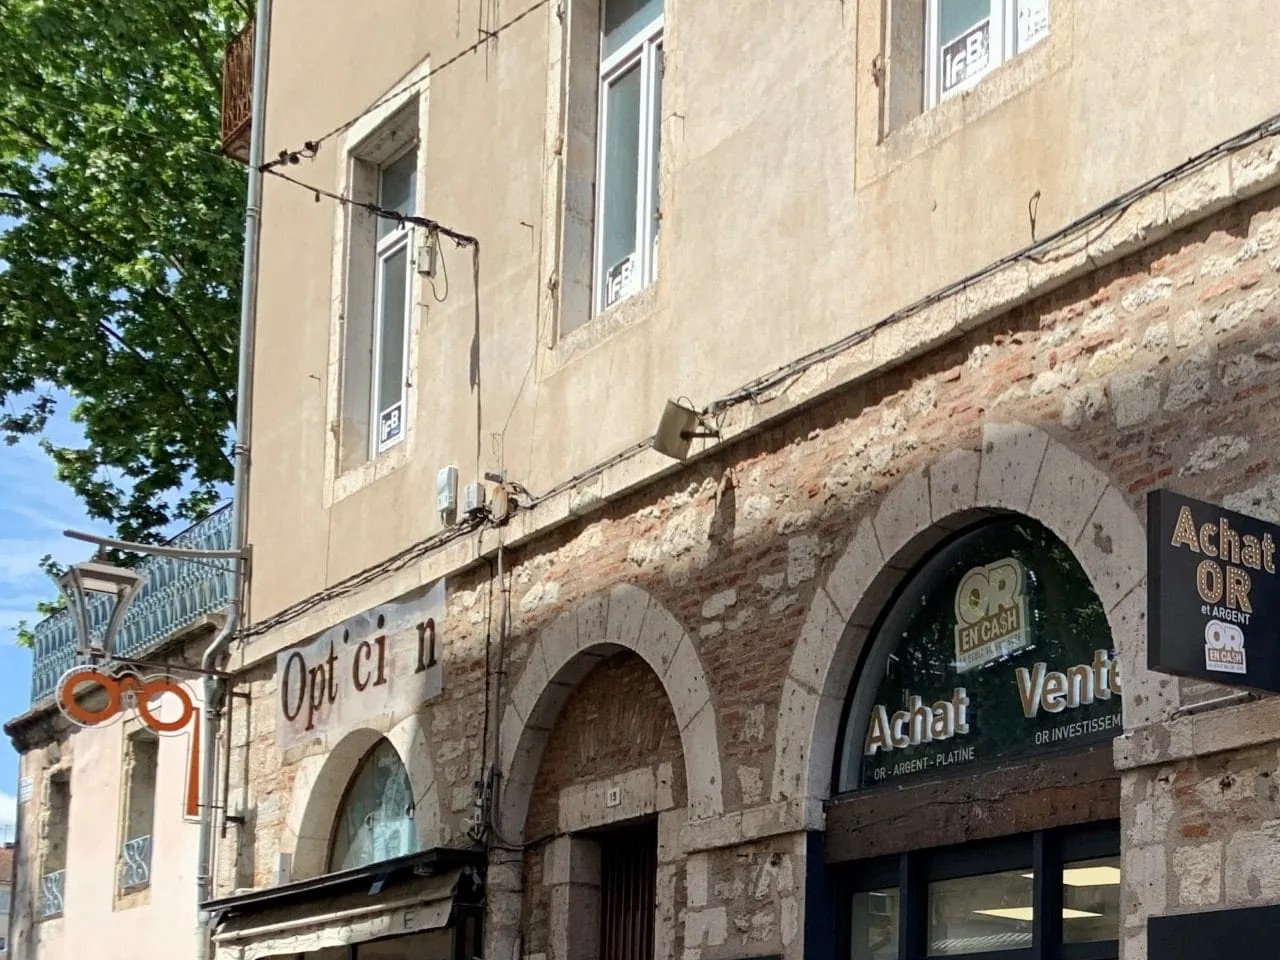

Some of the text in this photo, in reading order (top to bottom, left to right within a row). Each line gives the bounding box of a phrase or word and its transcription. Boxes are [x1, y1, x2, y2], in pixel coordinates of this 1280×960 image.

[1171, 505, 1276, 574] Achat
[958, 563, 1018, 624] OR
[1197, 560, 1252, 613] OR
[962, 626, 979, 650] EN
[1201, 604, 1250, 625] et ARGENT
[1206, 621, 1243, 651] OR
[281, 614, 437, 731] Optcin
[1015, 649, 1121, 718] Vente
[864, 687, 970, 755] Achat
[1035, 731, 1049, 744] OR
[874, 767, 885, 780] OR
[894, 758, 928, 776] ARGENT
[936, 747, 975, 768] PLATINE
